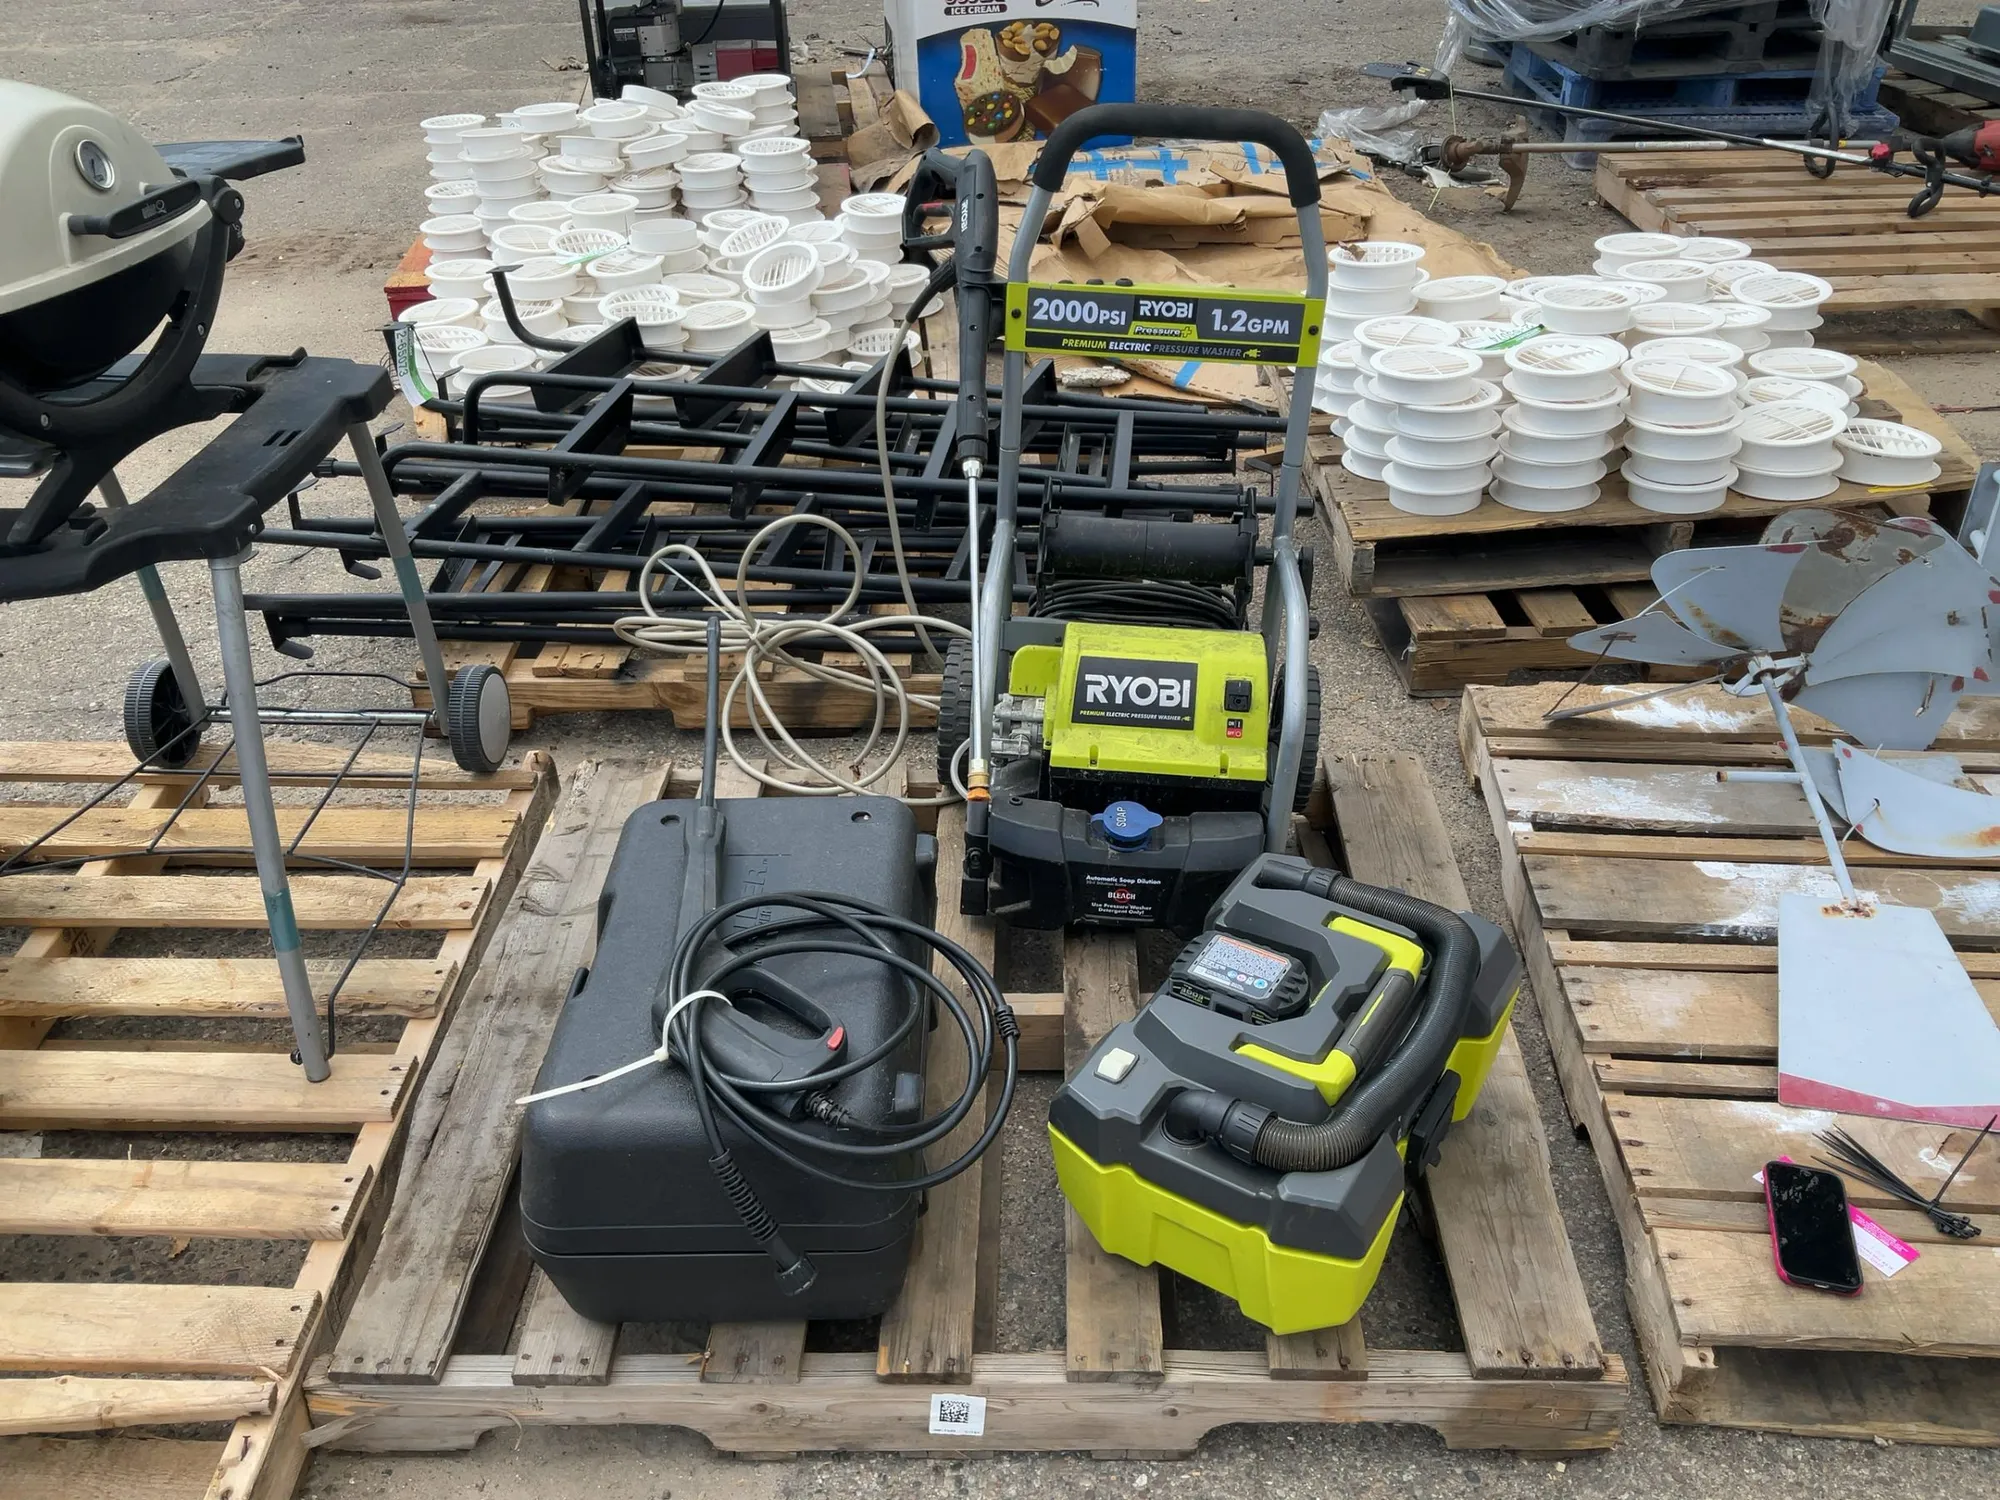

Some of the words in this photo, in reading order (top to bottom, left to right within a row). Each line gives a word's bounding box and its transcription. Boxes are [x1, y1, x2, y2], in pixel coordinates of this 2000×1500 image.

[951, 6, 967, 15] ICE
[968, 5, 1000, 14] CREAM
[1139, 299, 1193, 319] RYOBI
[1061, 338, 1107, 350] PREMIUM
[1108, 340, 1151, 352] ELECTRIC
[1153, 344, 1199, 355] PRESSURE
[1201, 346, 1242, 358] WASHER
[1084, 673, 1191, 708] RYOBI
[1079, 709, 1105, 717] PREMIUM
[1105, 711, 1130, 719] ELECTRIC
[1130, 712, 1158, 720] PRESSURE
[1158, 713, 1181, 721] WASHER
[1116, 807, 1126, 827] SOAP
[1108, 892, 1136, 900] BLEACH
